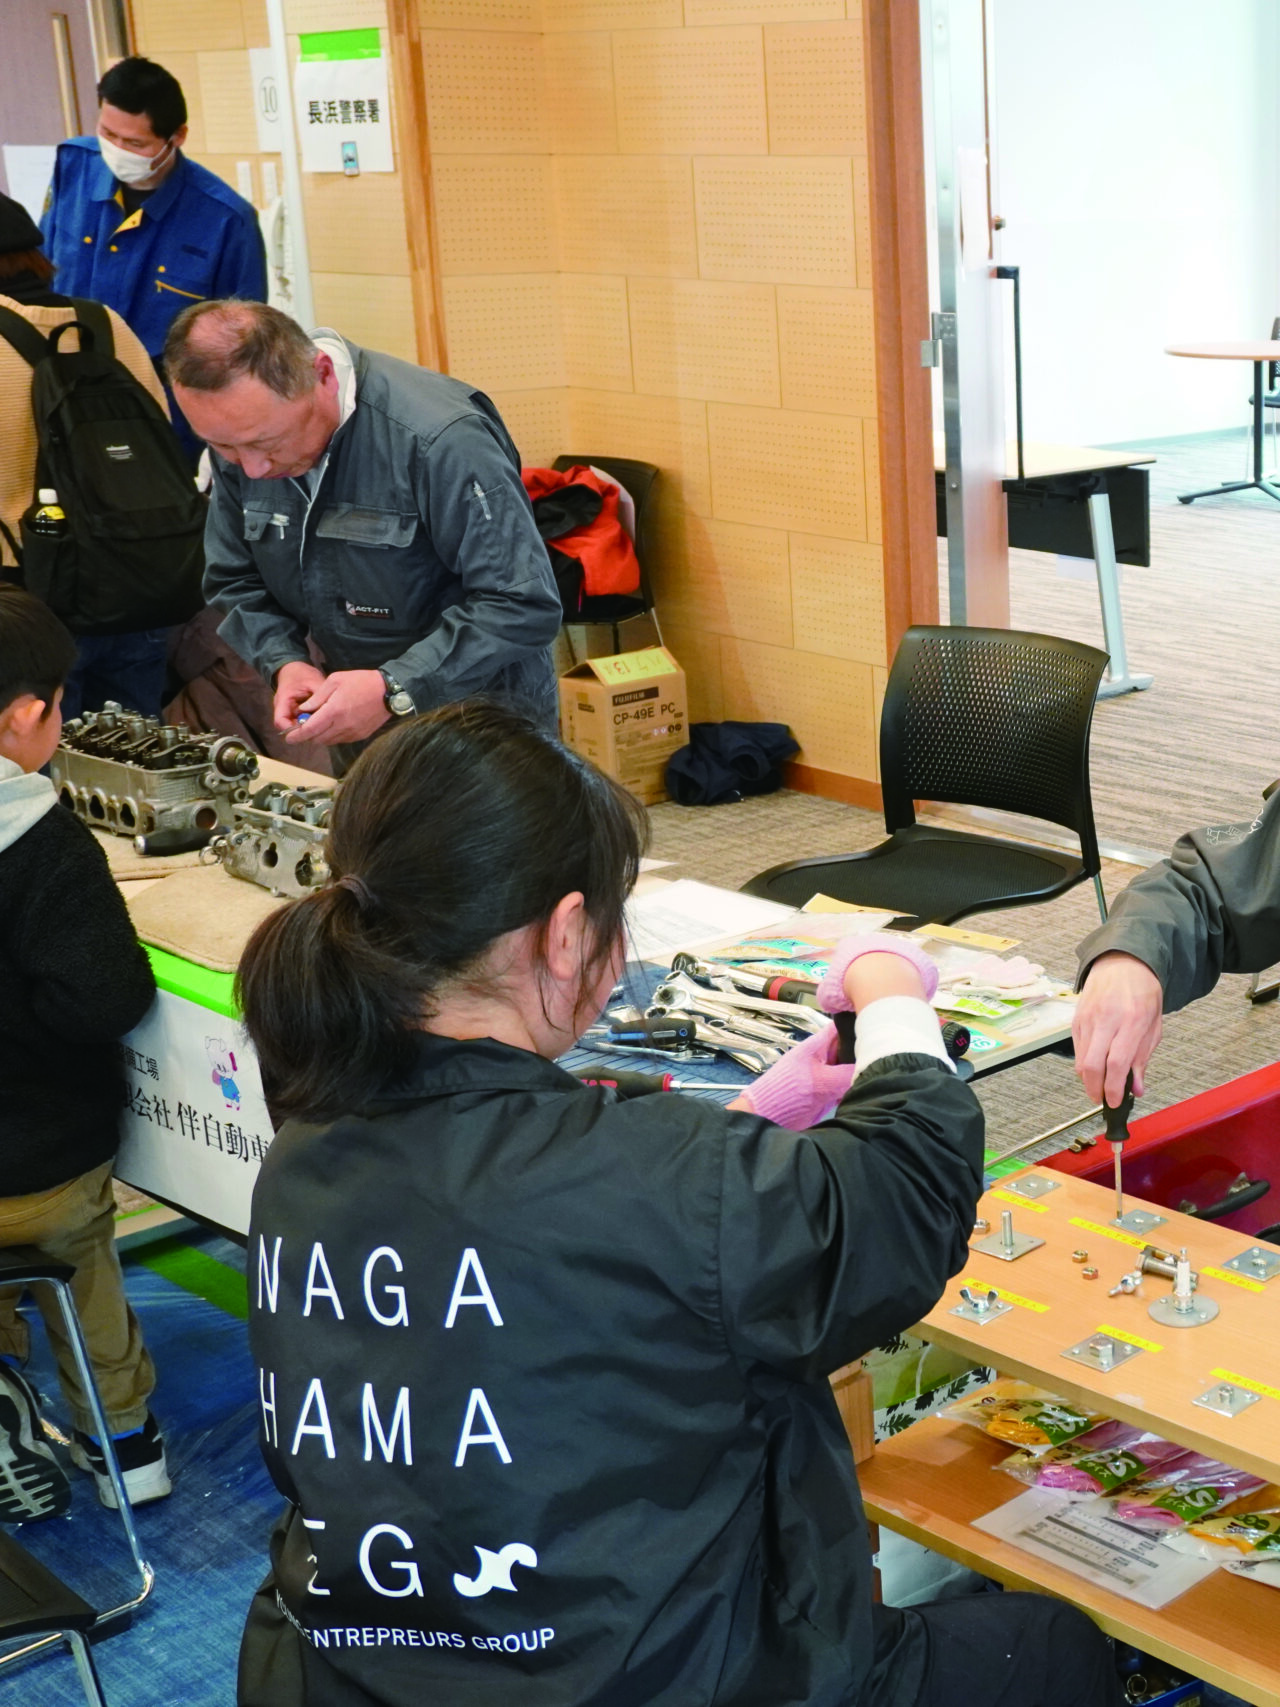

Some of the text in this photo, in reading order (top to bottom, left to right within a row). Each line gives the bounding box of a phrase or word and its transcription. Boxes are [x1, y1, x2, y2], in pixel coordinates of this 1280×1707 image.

[309, 99, 380, 125] 長浜警察署
[613, 706, 655, 726] CP-49E
[660, 702, 676, 716] PC
[257, 1233, 504, 1329] NAGA
[259, 1367, 513, 1468] HAMA
[472, 1626, 556, 1653] GROUP
